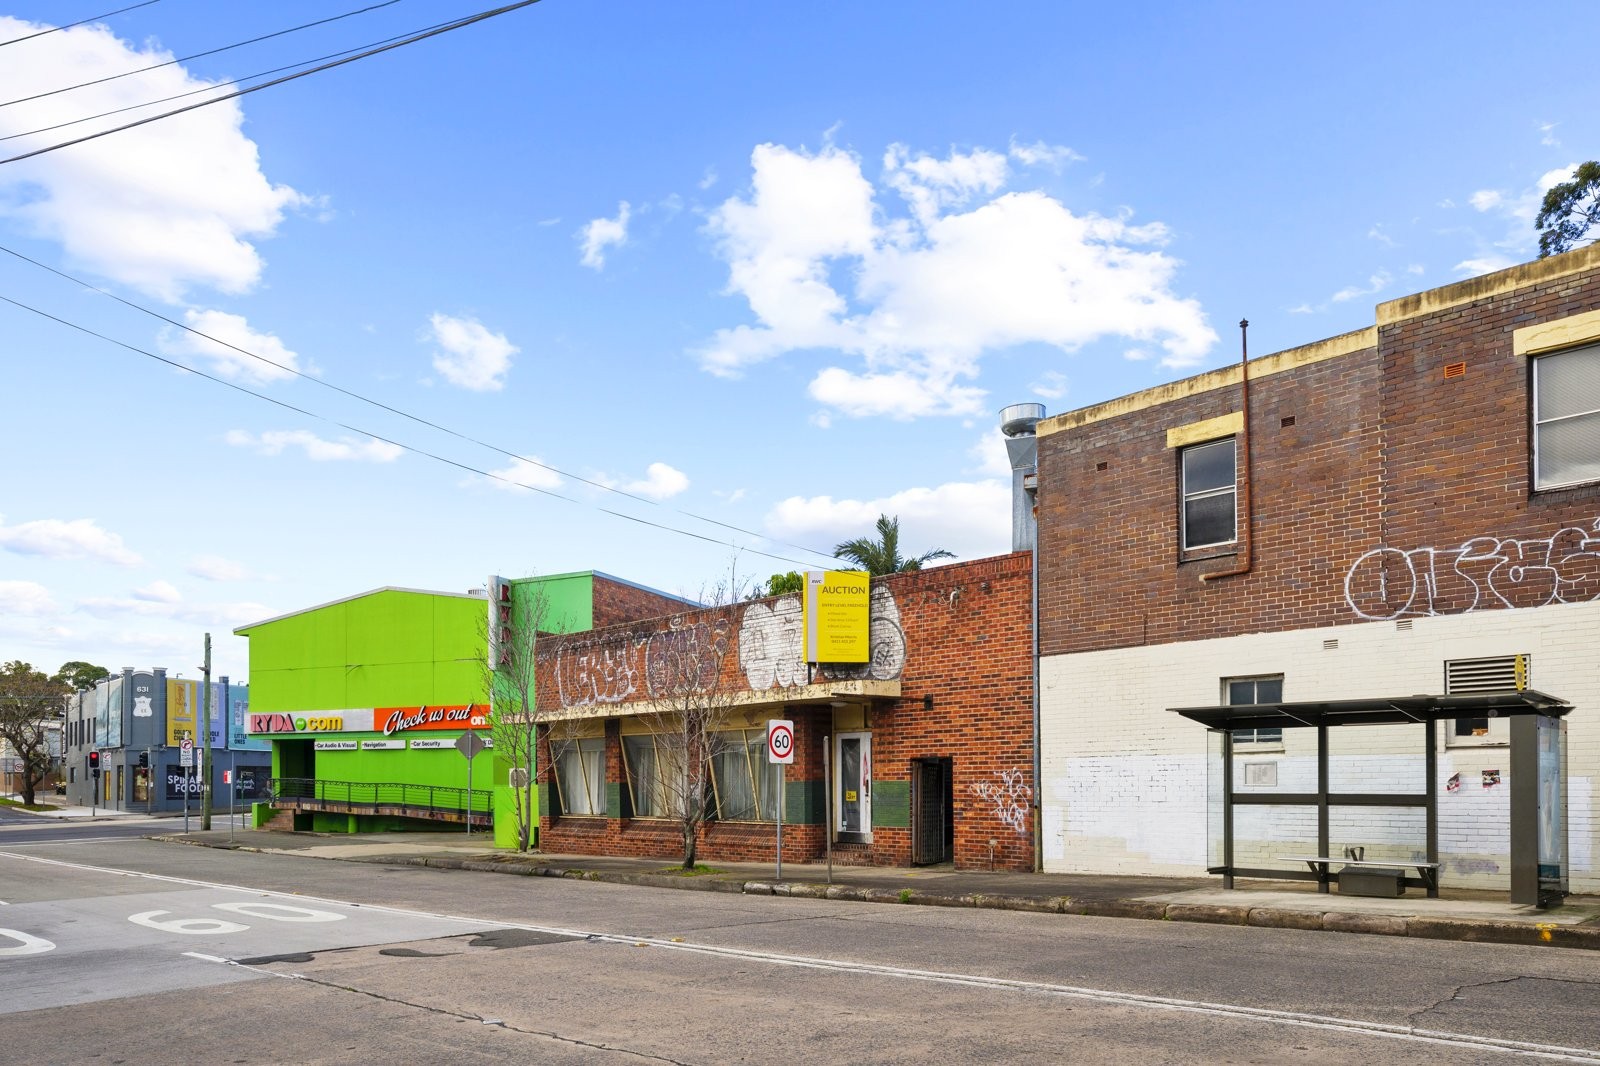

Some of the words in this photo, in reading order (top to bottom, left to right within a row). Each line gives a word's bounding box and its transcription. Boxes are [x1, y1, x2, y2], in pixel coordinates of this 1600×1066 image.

[822, 586, 865, 594] AUCTION
[500, 584, 511, 664] RYDA
[250, 714, 295, 732] RYDA
[307, 717, 343, 730] com
[384, 705, 427, 736] Check
[429, 708, 444, 721] us
[447, 703, 473, 720] out
[774, 734, 789, 749] 60
[127, 902, 347, 935] 60
